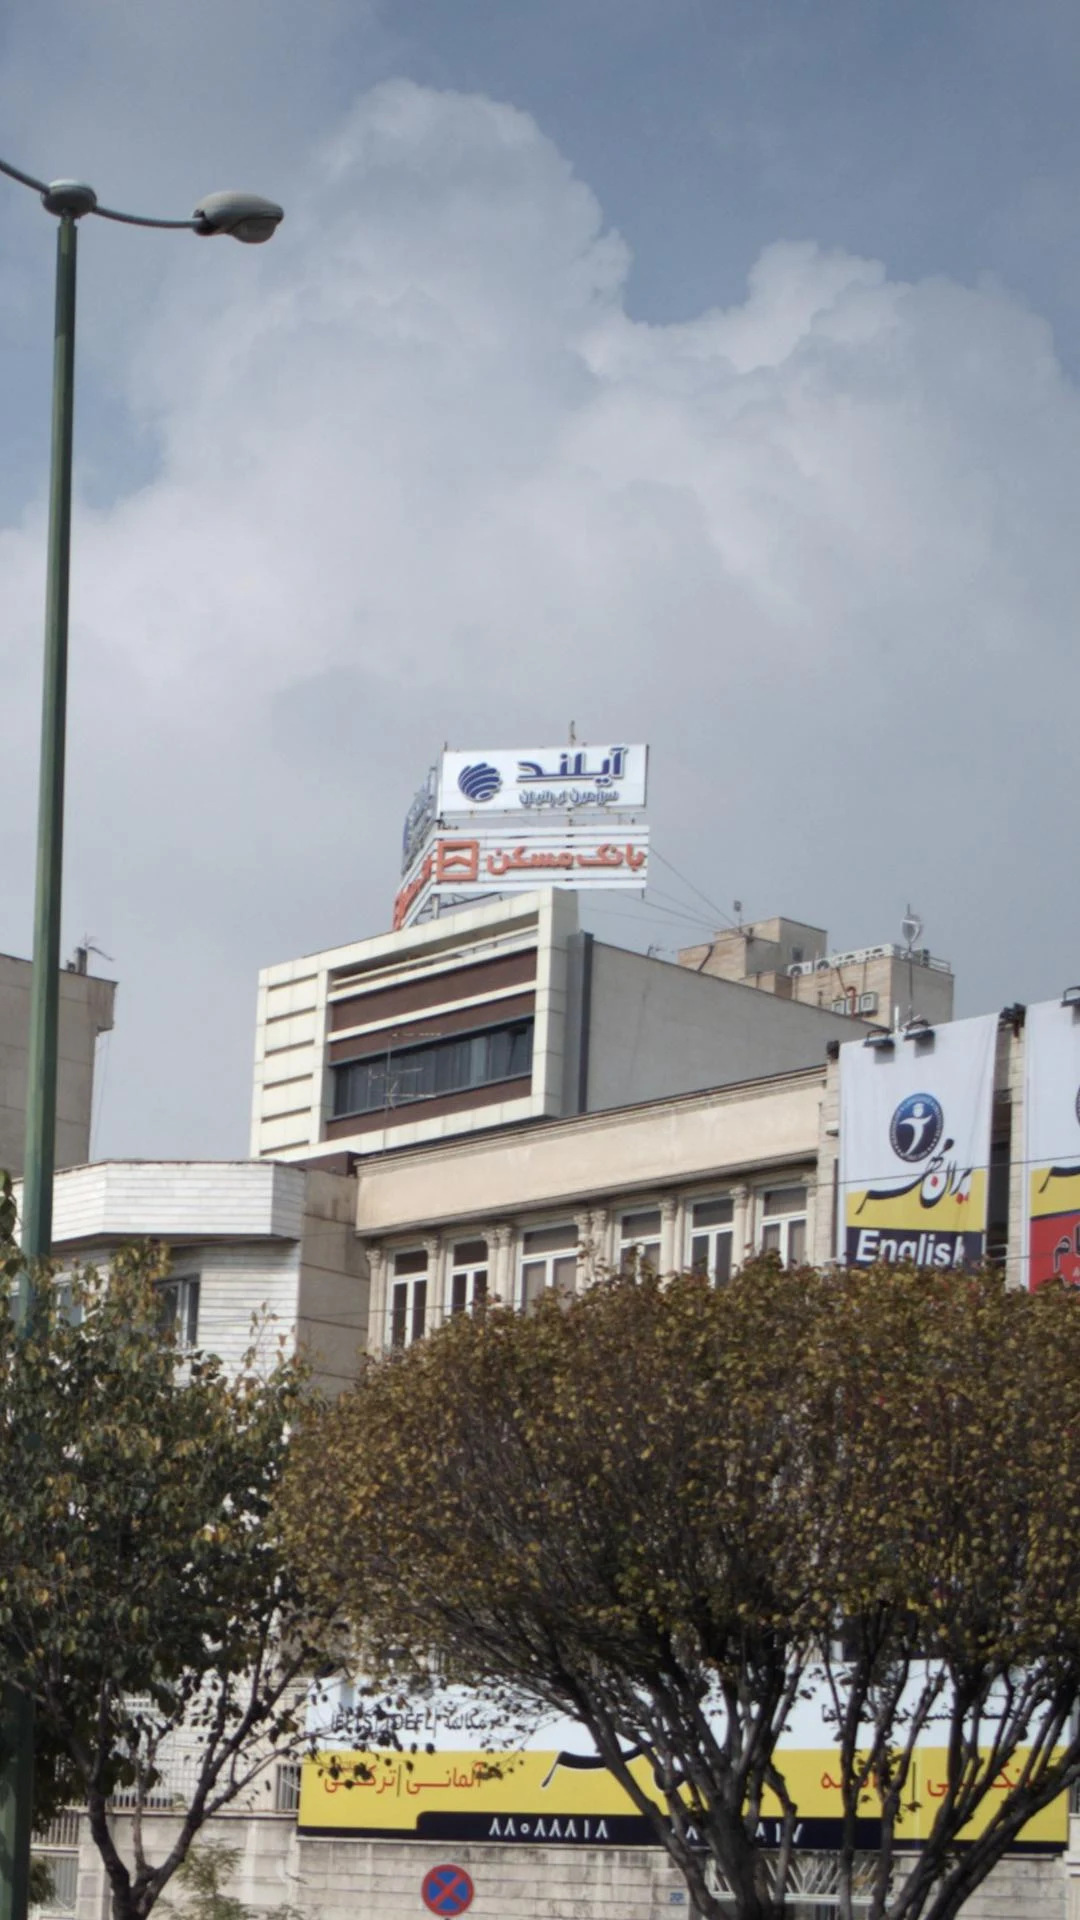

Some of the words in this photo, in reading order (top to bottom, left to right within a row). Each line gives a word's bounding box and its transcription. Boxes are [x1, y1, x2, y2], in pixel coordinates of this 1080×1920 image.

[487, 846, 574, 876] مسکن
[577, 843, 646, 872] بانک
[489, 1817, 608, 1839] ۸۸۰۸۸۸۱۸
